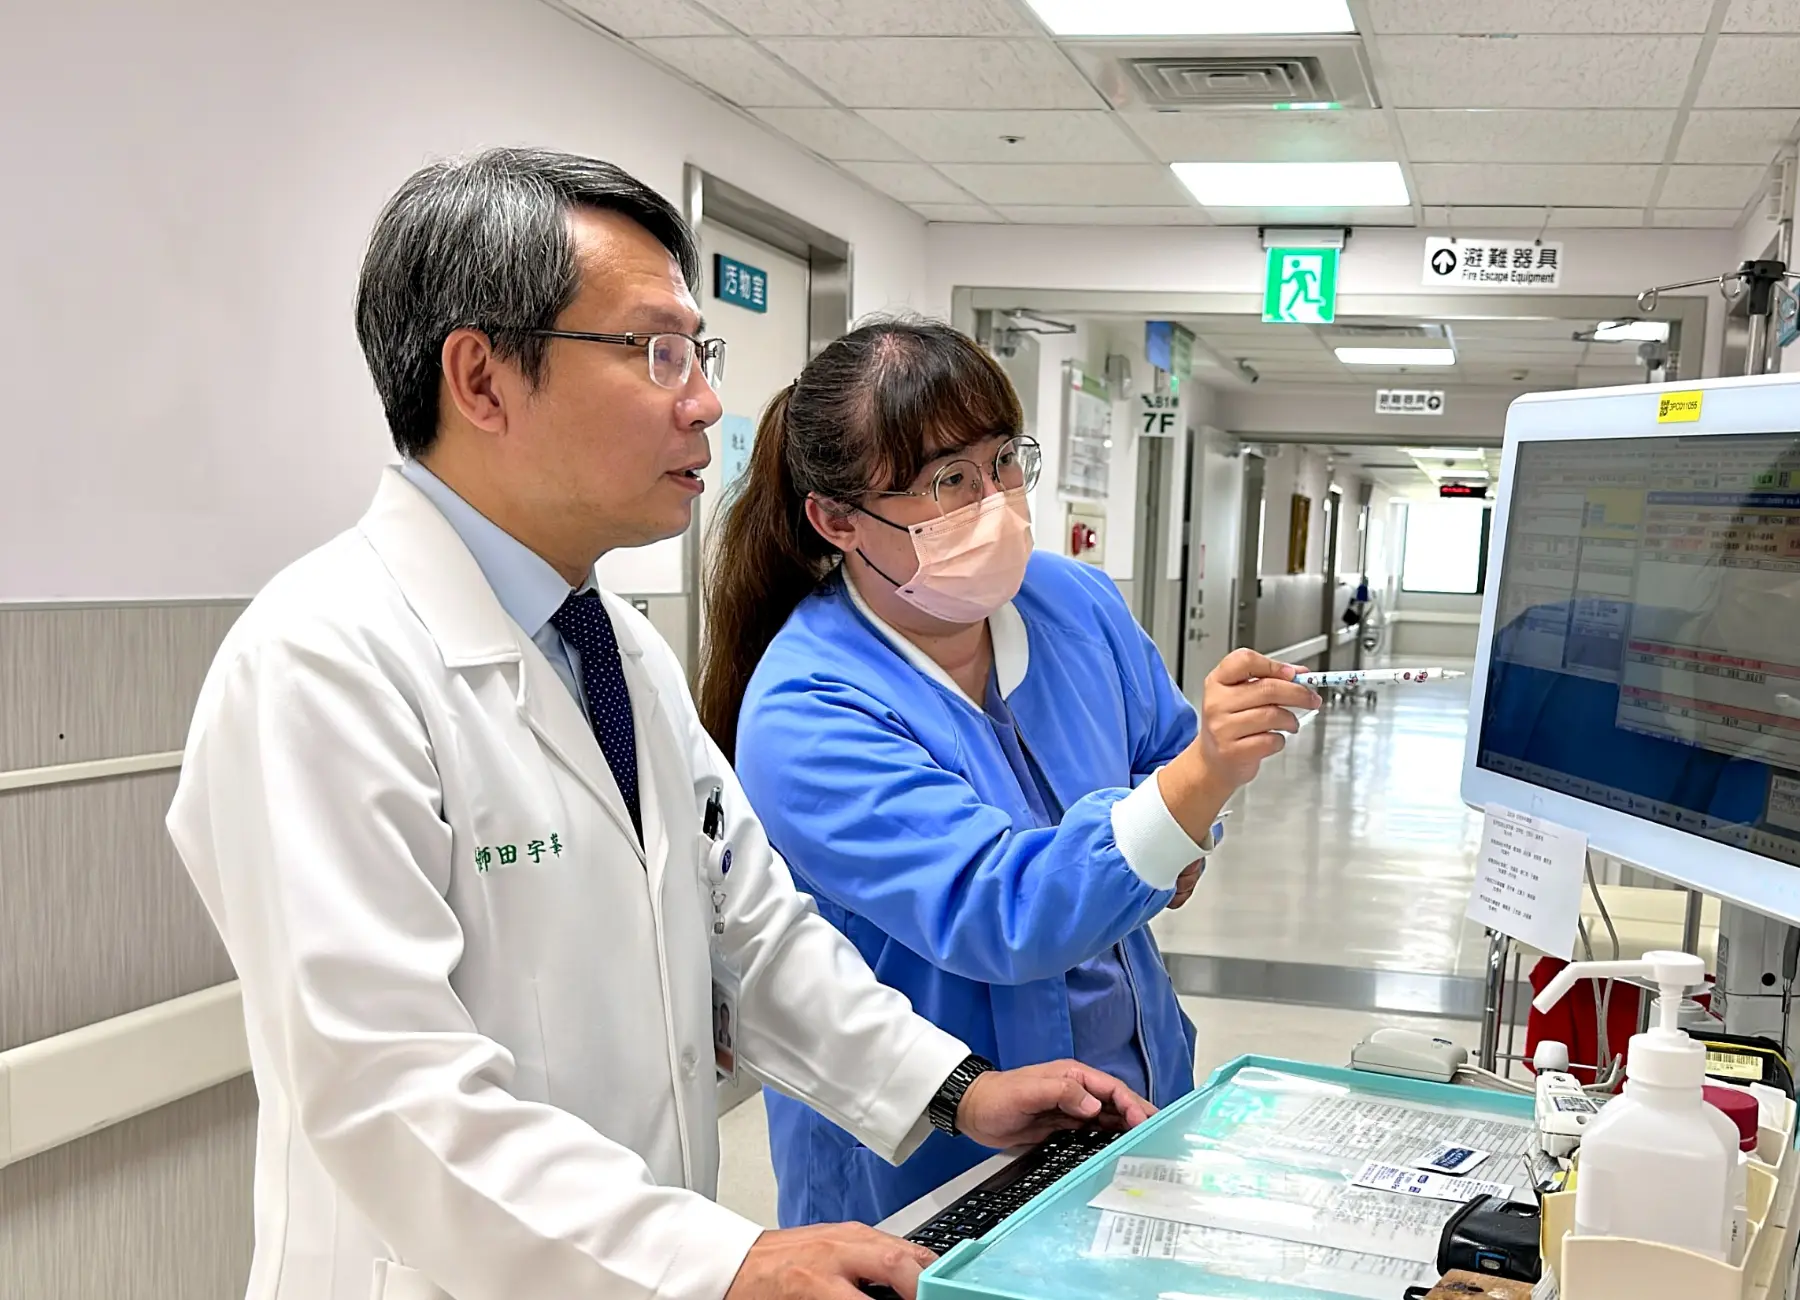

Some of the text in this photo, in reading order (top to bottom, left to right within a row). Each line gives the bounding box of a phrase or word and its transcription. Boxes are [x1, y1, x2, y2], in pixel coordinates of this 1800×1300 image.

[1463, 247, 1557, 270] 避難器具
[1462, 269, 1555, 285] Fire Escape Equipment
[1143, 412, 1176, 434] 7F
